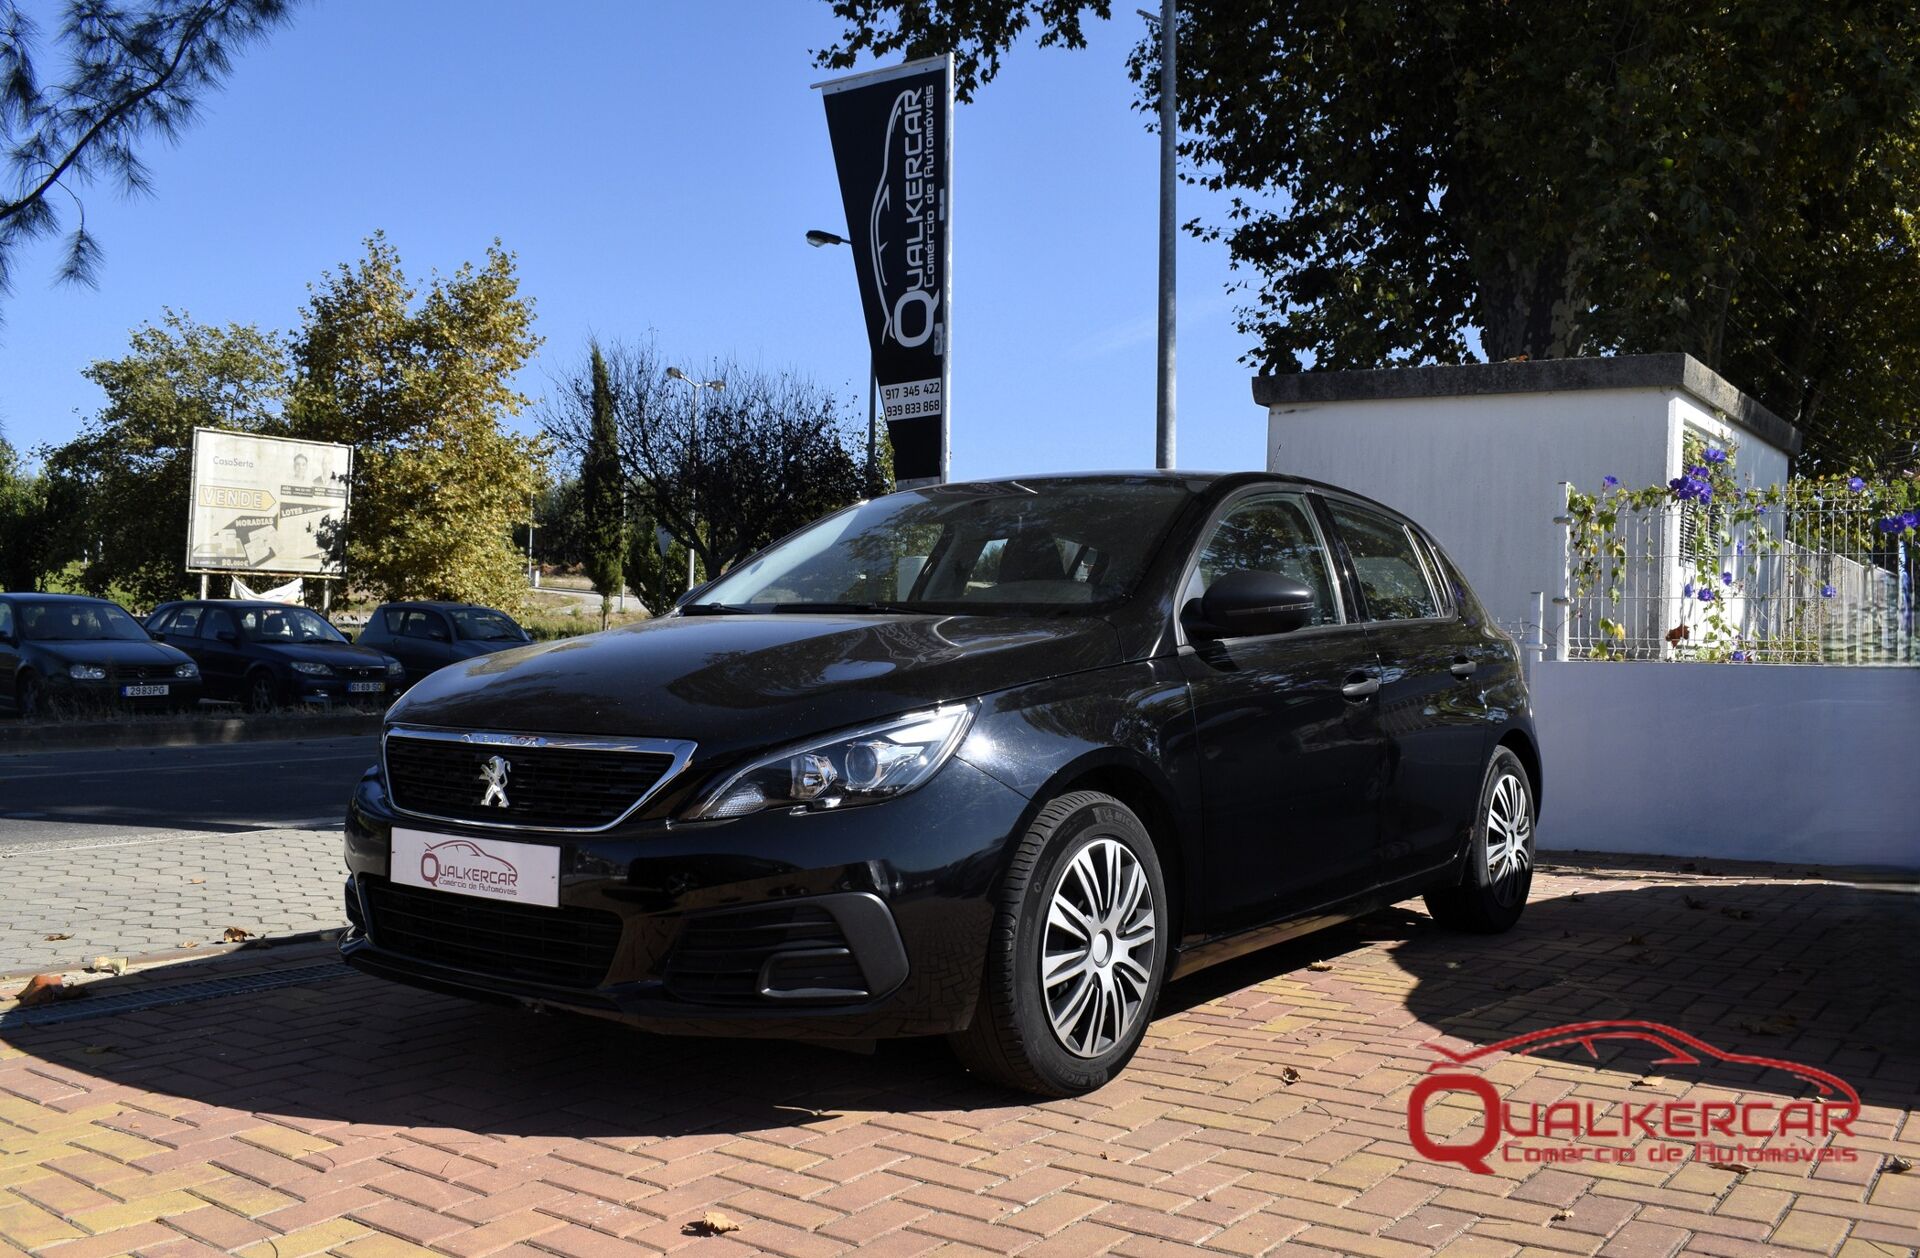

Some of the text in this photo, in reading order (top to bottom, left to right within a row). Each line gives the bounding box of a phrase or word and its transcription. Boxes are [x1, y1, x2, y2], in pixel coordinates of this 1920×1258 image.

[923, 84, 935, 288] Comércio de Automóveis
[894, 87, 940, 348] QUALKERCAR
[885, 382, 940, 400] 917 345 422
[886, 399, 940, 417] 939 833 868
[202, 486, 263, 509] VENDE
[281, 506, 304, 517] LOTES
[235, 517, 274, 527] MORADIAS
[420, 852, 518, 887] QUALKERCAR
[469, 881, 477, 890] de
[478, 882, 518, 896] Automóveis
